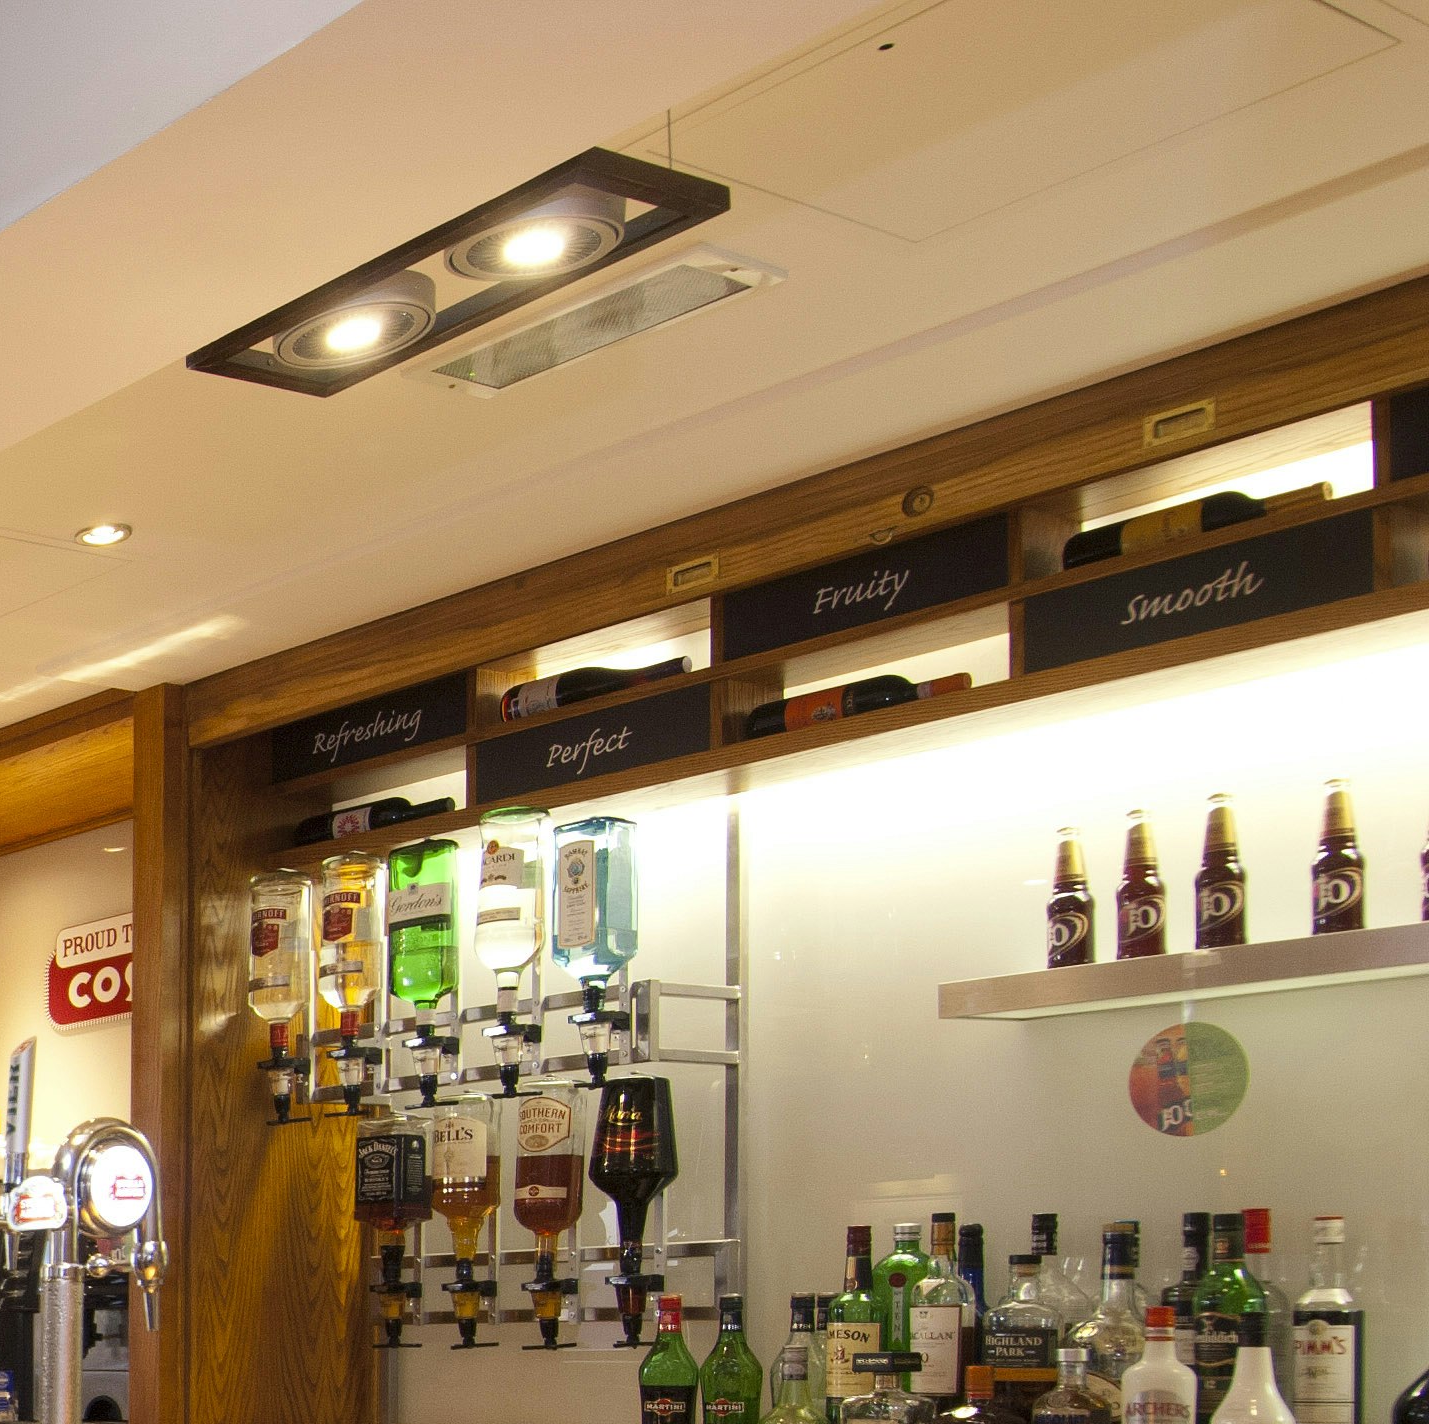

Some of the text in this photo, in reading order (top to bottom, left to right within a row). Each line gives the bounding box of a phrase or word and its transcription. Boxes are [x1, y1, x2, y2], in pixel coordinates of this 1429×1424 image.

[812, 567, 911, 615] Fruity
[1121, 561, 1264, 625] Smooth
[313, 708, 423, 763] Refreshing
[546, 725, 633, 775] Perfect
[483, 852, 515, 866] CARDI
[63, 924, 132, 958] PROUD T
[519, 1107, 566, 1120] SOUTHERN
[434, 1127, 474, 1143] BELL'S
[519, 1123, 562, 1134] COMFORT
[359, 1145, 373, 1158] JACK
[827, 1329, 870, 1343] MESON
[912, 1331, 953, 1341] CALLAN
[986, 1336, 1042, 1346] HIGHLAND
[996, 1346, 1025, 1357] PARK
[646, 1403, 683, 1411] MARTINI
[1125, 1402, 1190, 1418] ARCHERS
